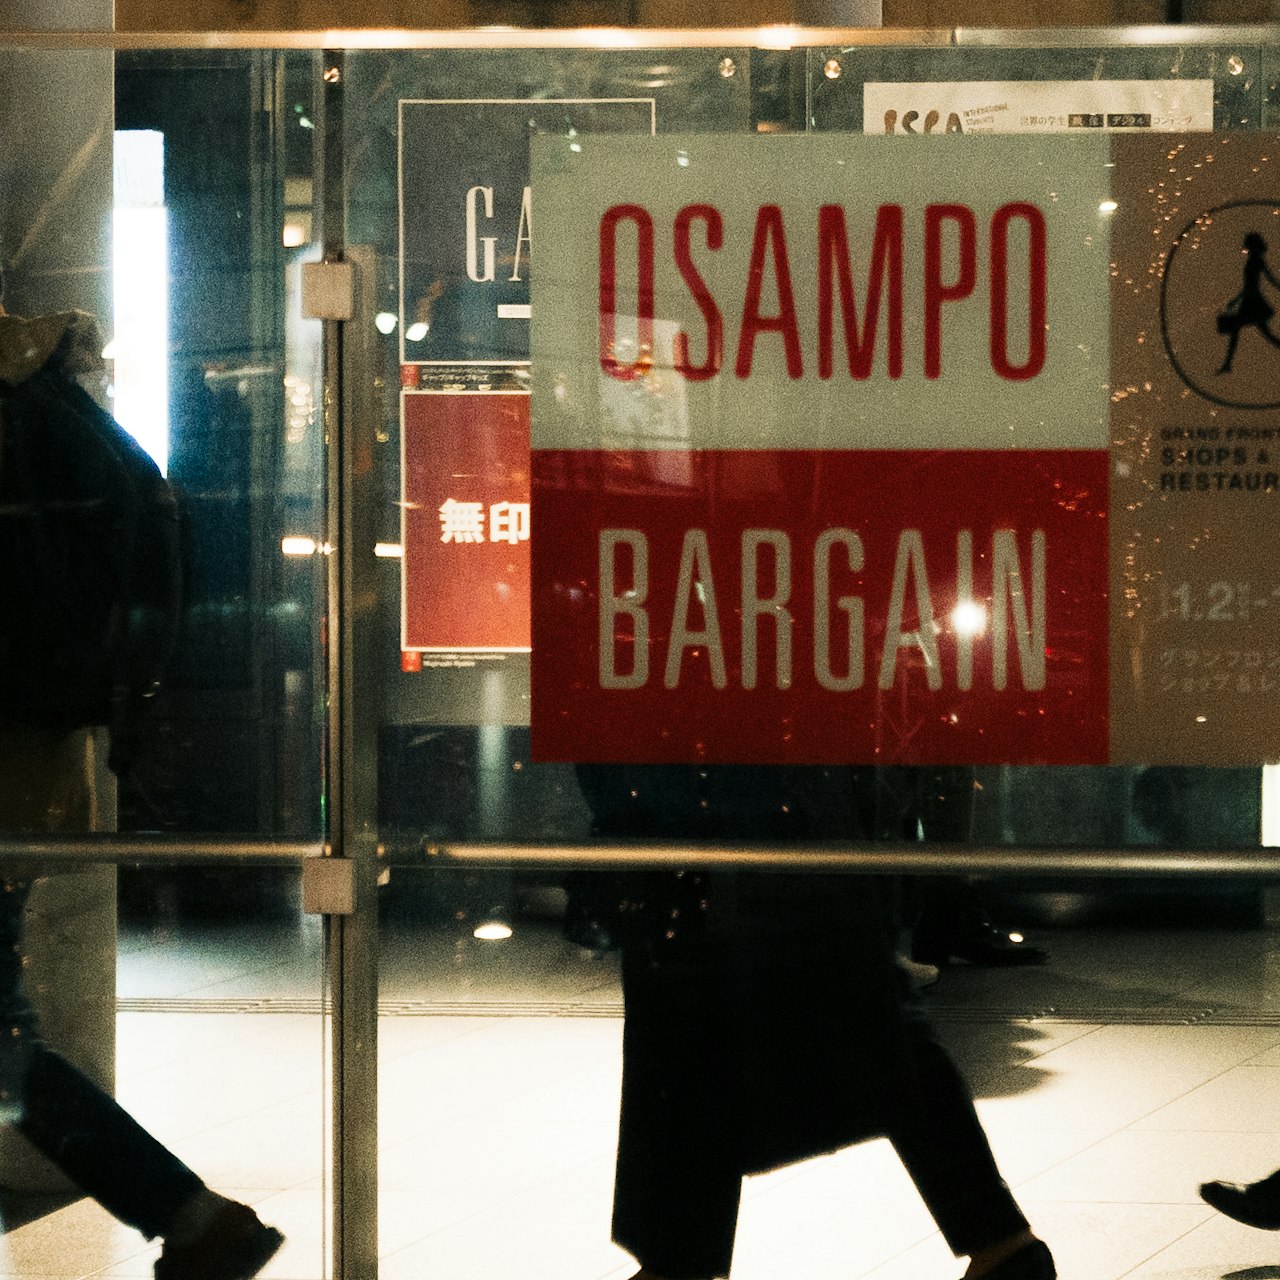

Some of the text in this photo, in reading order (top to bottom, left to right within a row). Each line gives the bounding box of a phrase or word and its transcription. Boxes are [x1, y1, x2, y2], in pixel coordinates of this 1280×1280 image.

[599, 203, 1048, 381] OSAMPO
[439, 498, 531, 544] 無印
[599, 528, 1047, 692] BARGAIN
